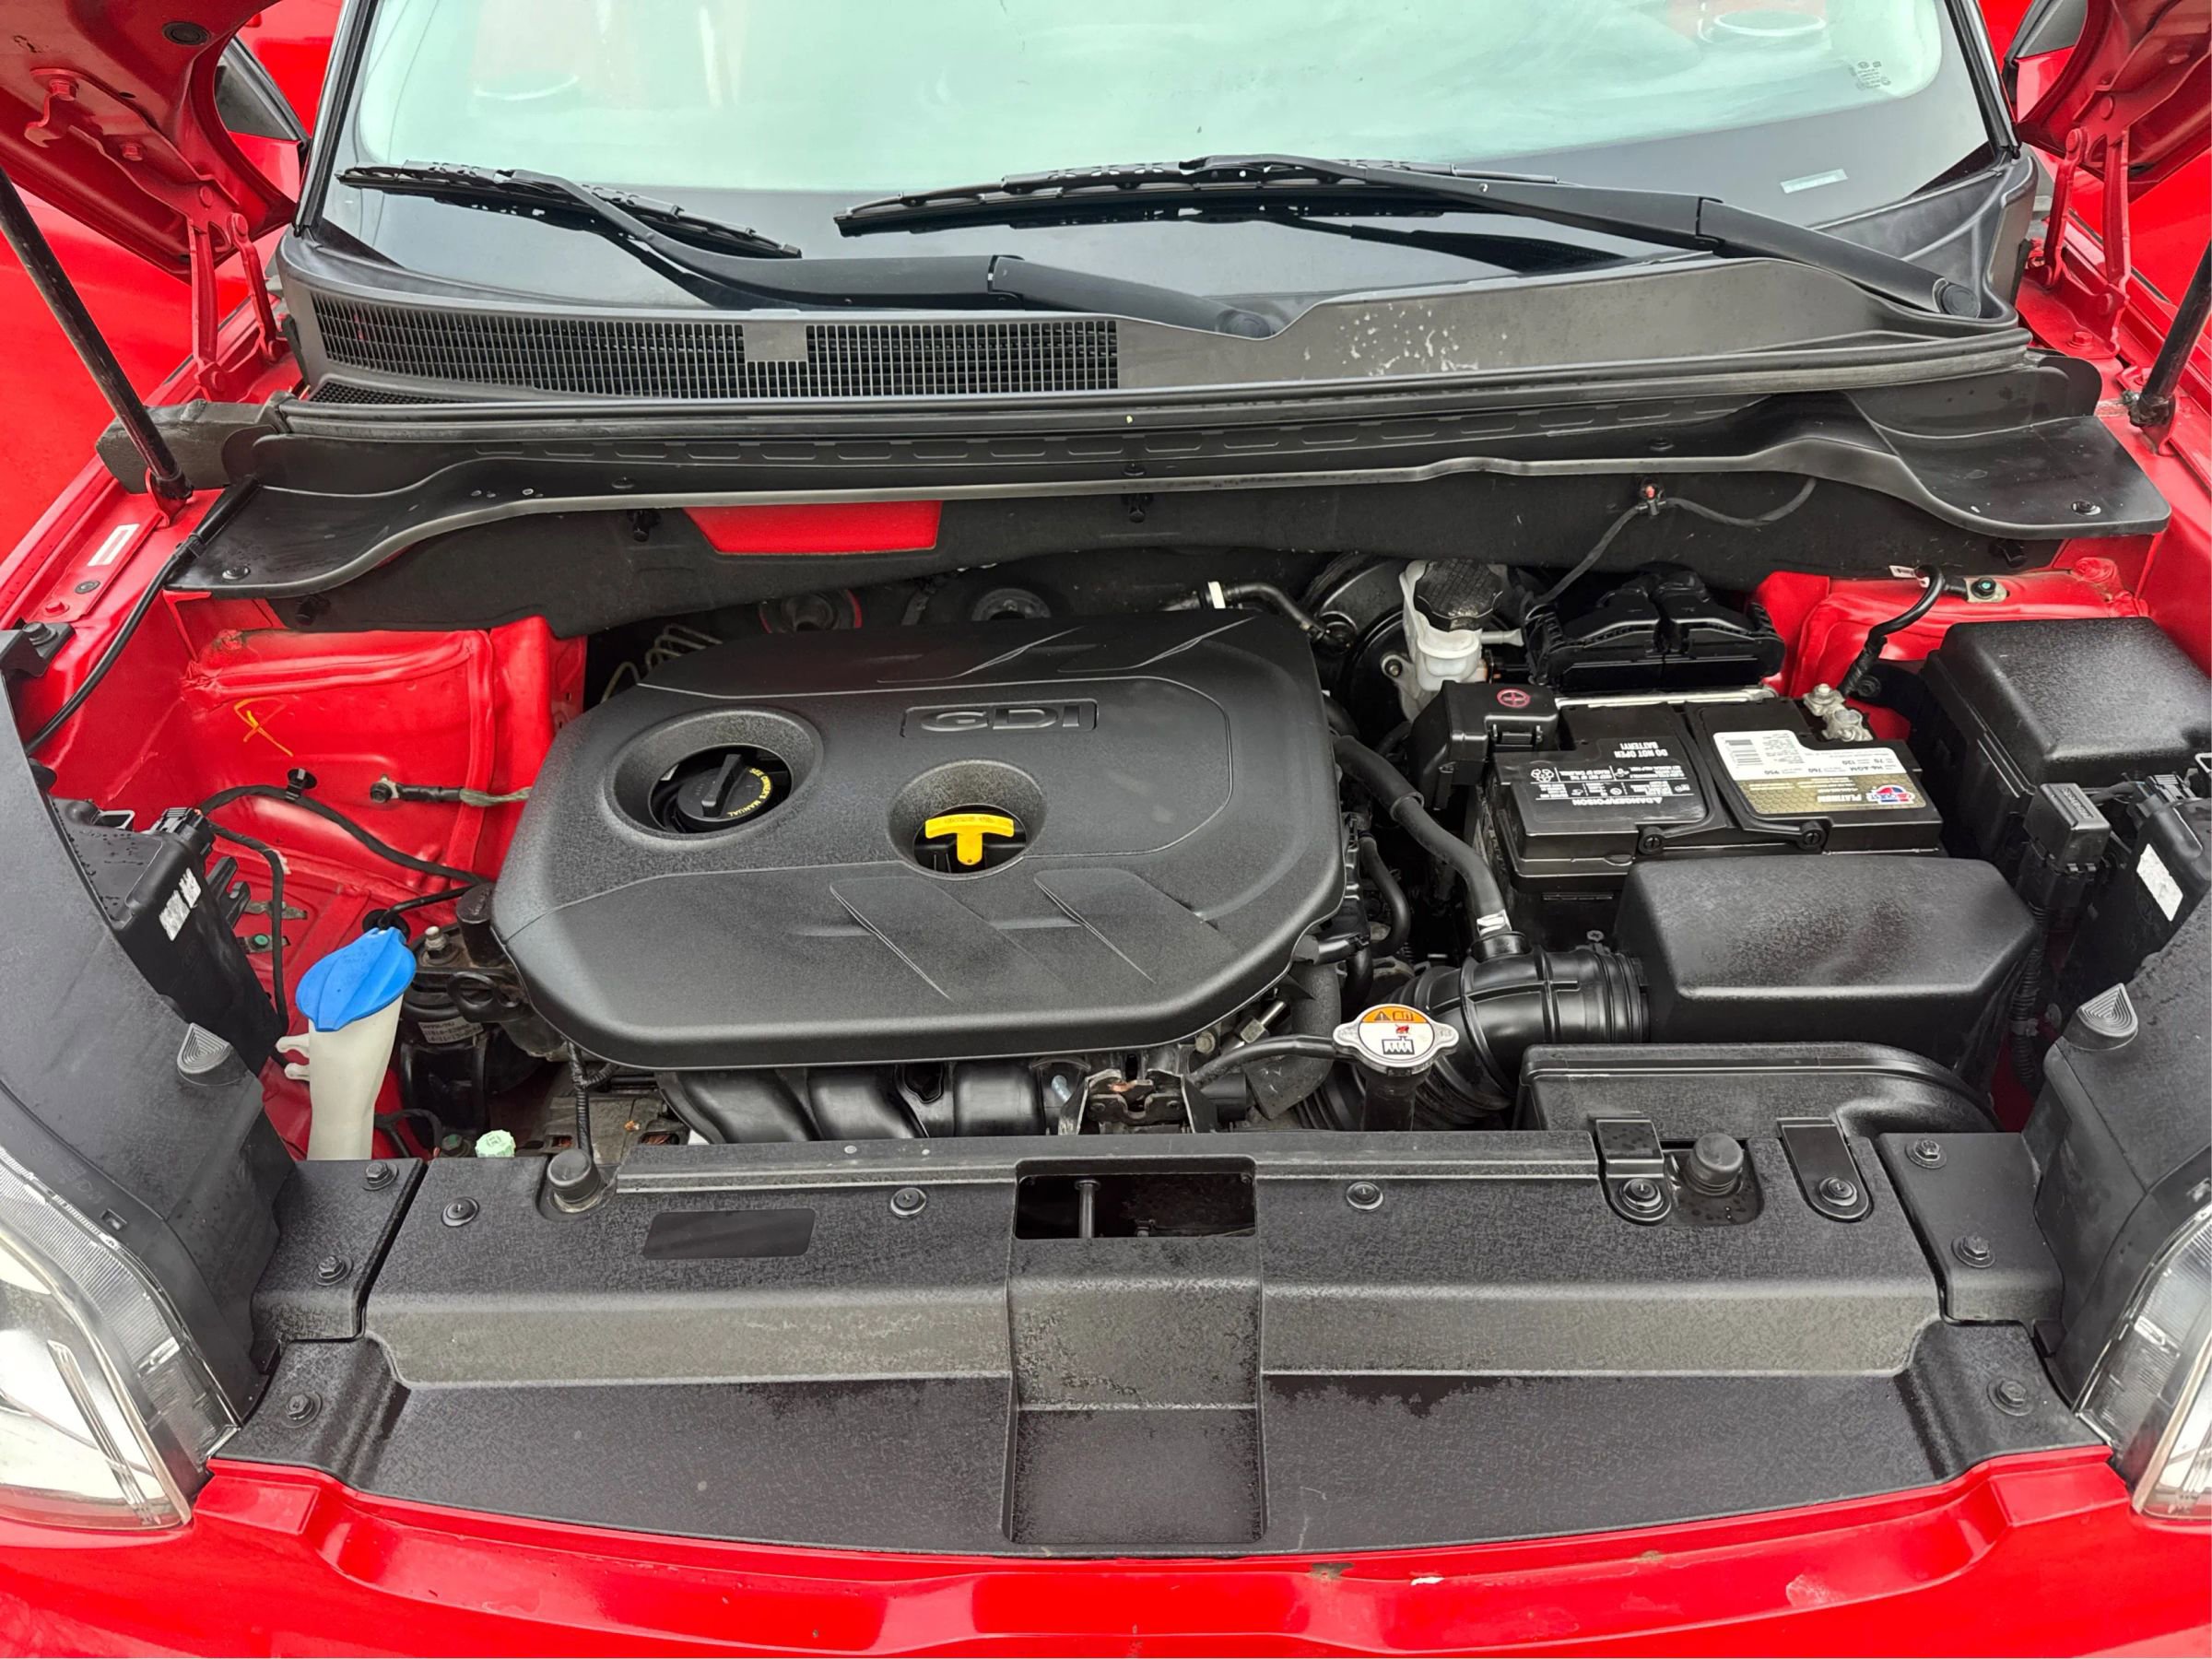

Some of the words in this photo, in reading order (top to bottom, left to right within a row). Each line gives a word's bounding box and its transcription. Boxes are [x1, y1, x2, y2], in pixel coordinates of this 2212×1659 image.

[920, 704, 1082, 732] GDI
[1619, 741, 1658, 750] BATTERY!
[1614, 749, 1637, 759] OPEN
[1638, 749, 1653, 758] NOT
[1655, 748, 1668, 758] DO
[749, 768, 765, 776] SEE
[1817, 794, 1862, 803] PLATINUM
[727, 800, 761, 817] MANUAL
